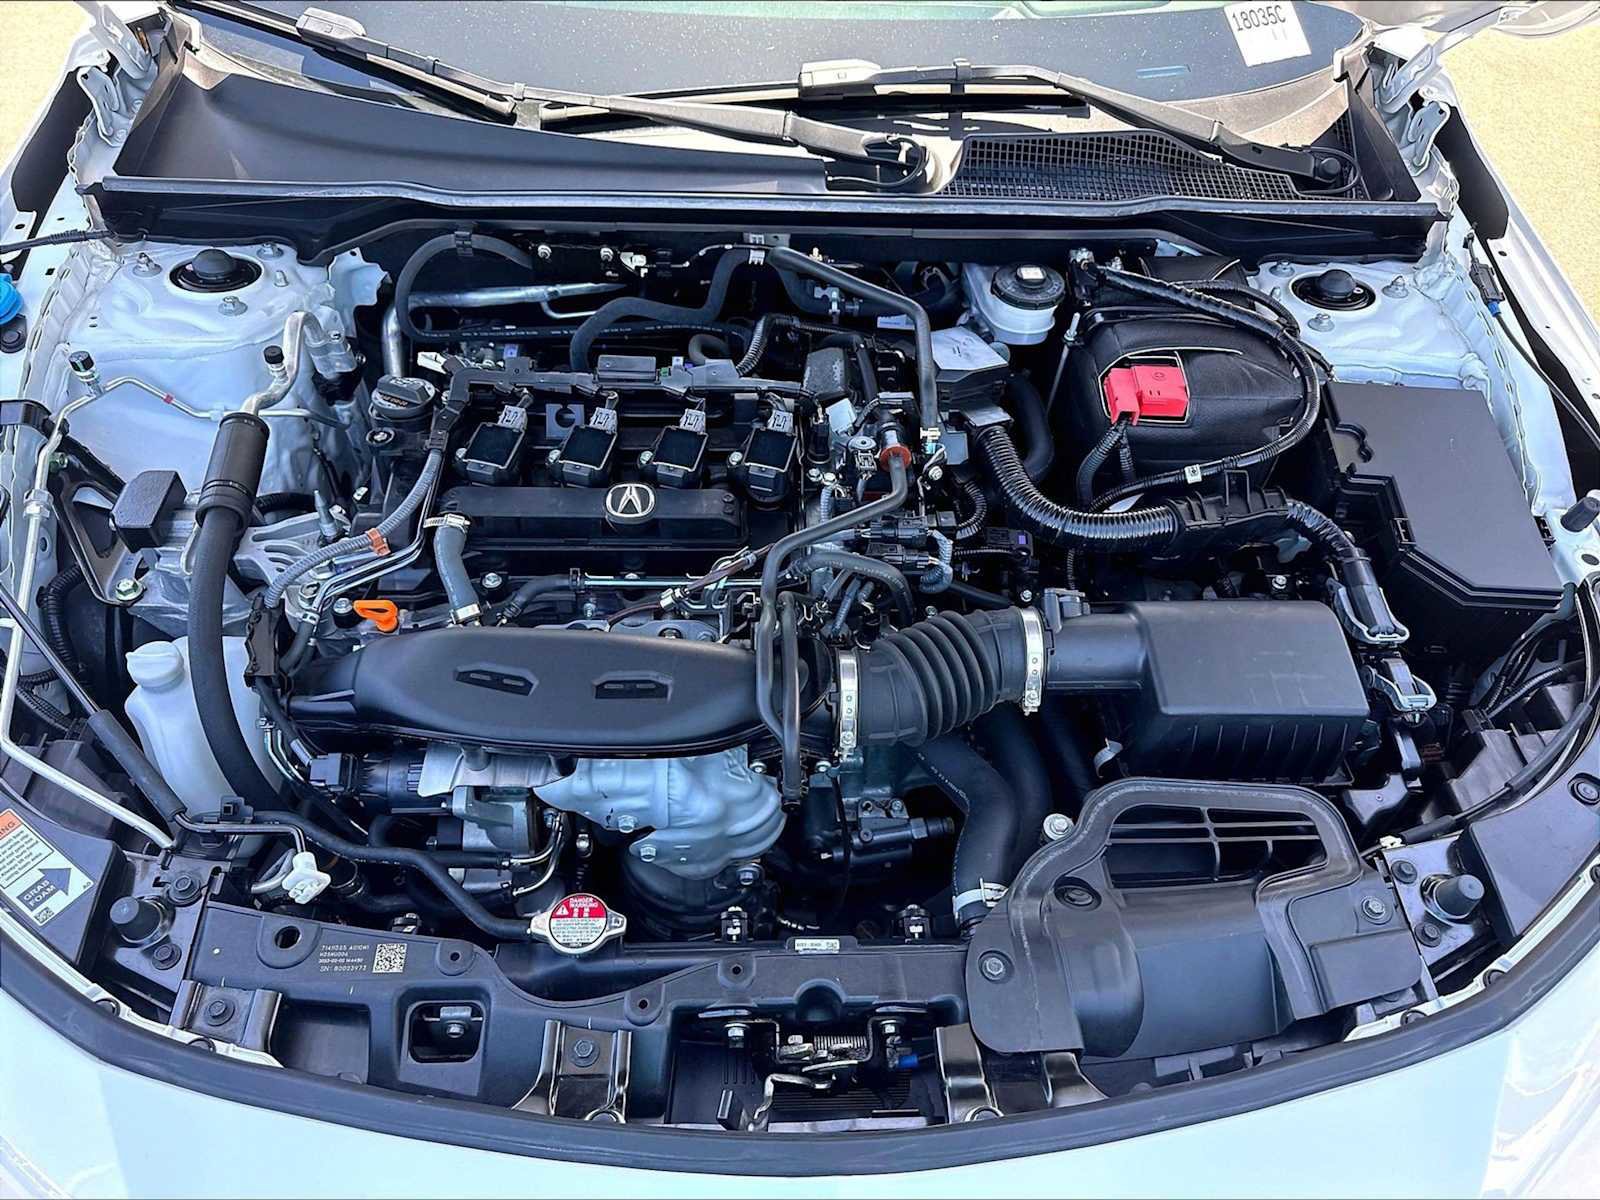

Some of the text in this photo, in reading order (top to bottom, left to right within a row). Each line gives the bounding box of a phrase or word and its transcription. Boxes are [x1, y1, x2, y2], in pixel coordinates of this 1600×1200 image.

[1232, 5, 1286, 31] 18035C
[23, 879, 50, 901] GRAB
[29, 884, 56, 907] FOAM
